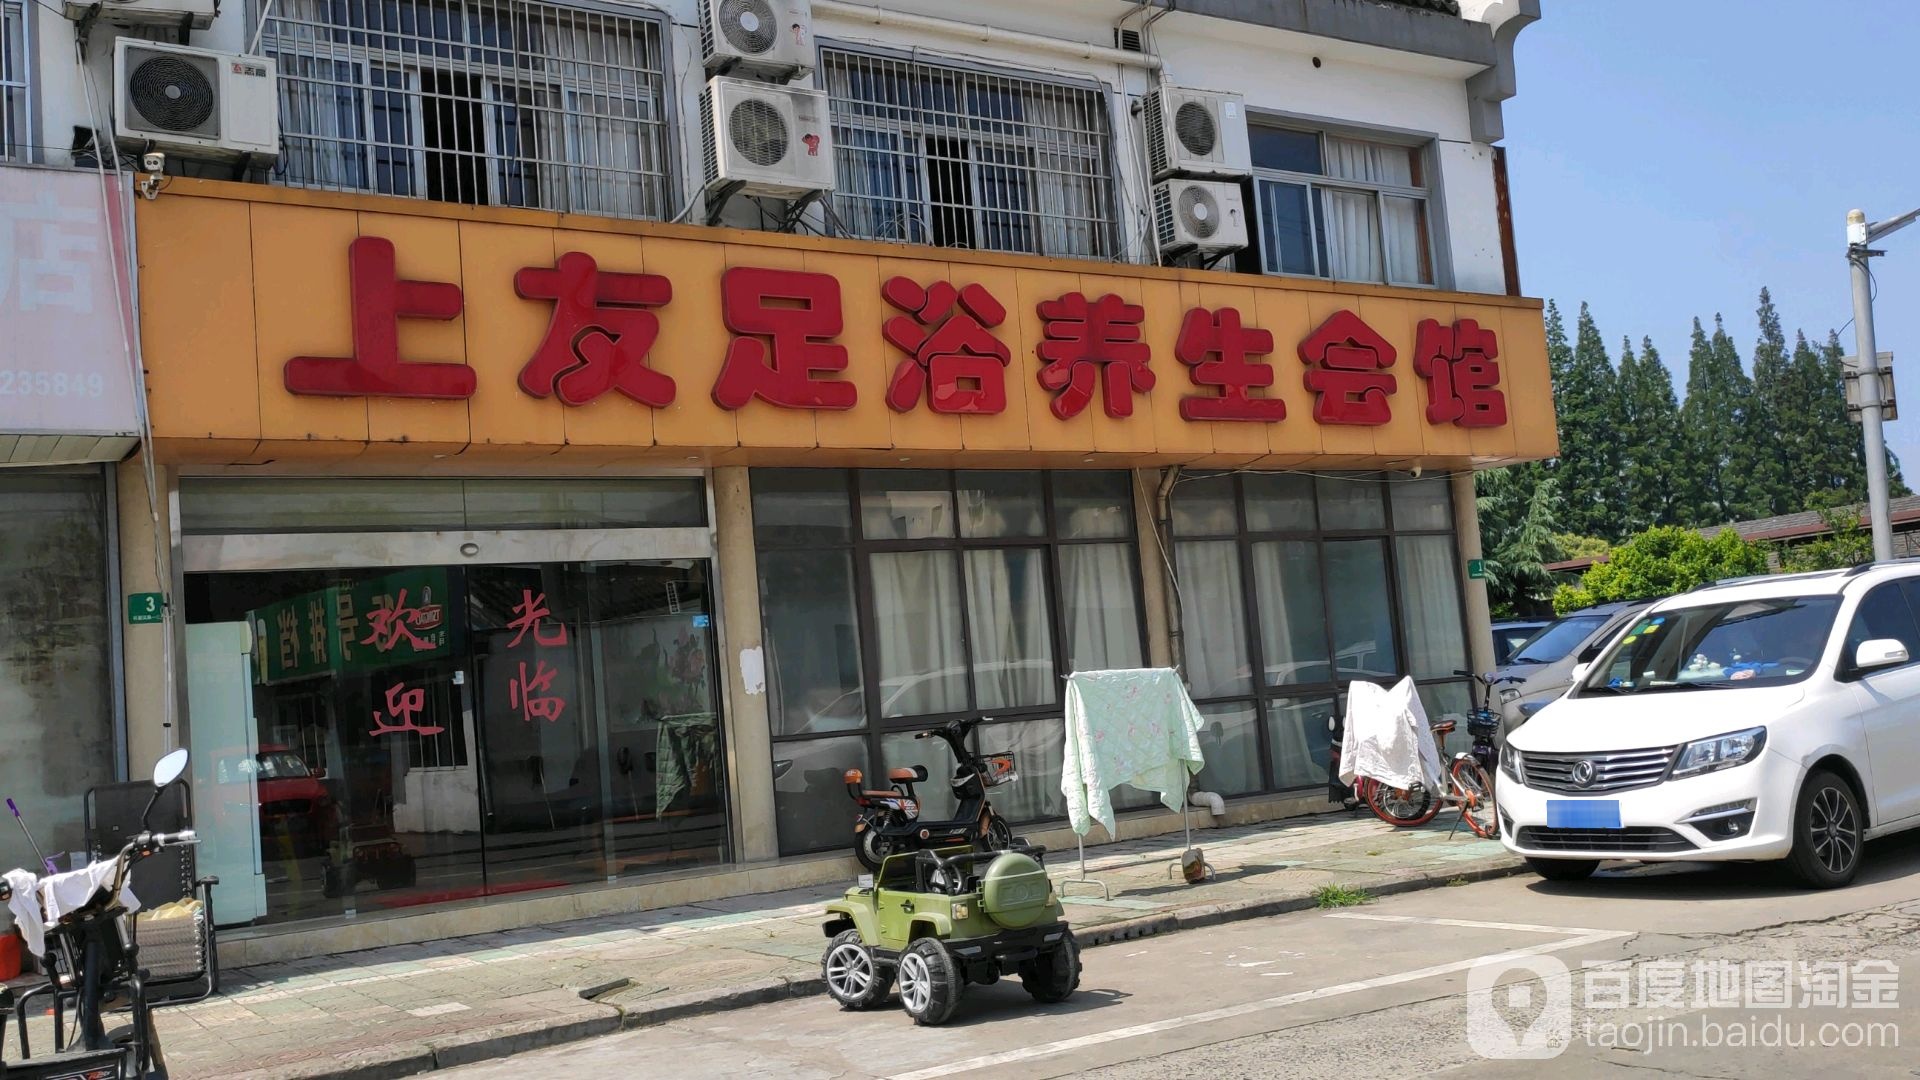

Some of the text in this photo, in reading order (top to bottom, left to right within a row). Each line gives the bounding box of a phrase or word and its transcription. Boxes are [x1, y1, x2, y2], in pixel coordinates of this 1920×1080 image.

[284, 236, 1508, 428] 上友足浴养生会馆
[145, 596, 156, 612] 3
[360, 588, 445, 737] 欢迎
[506, 589, 568, 722] 光临
